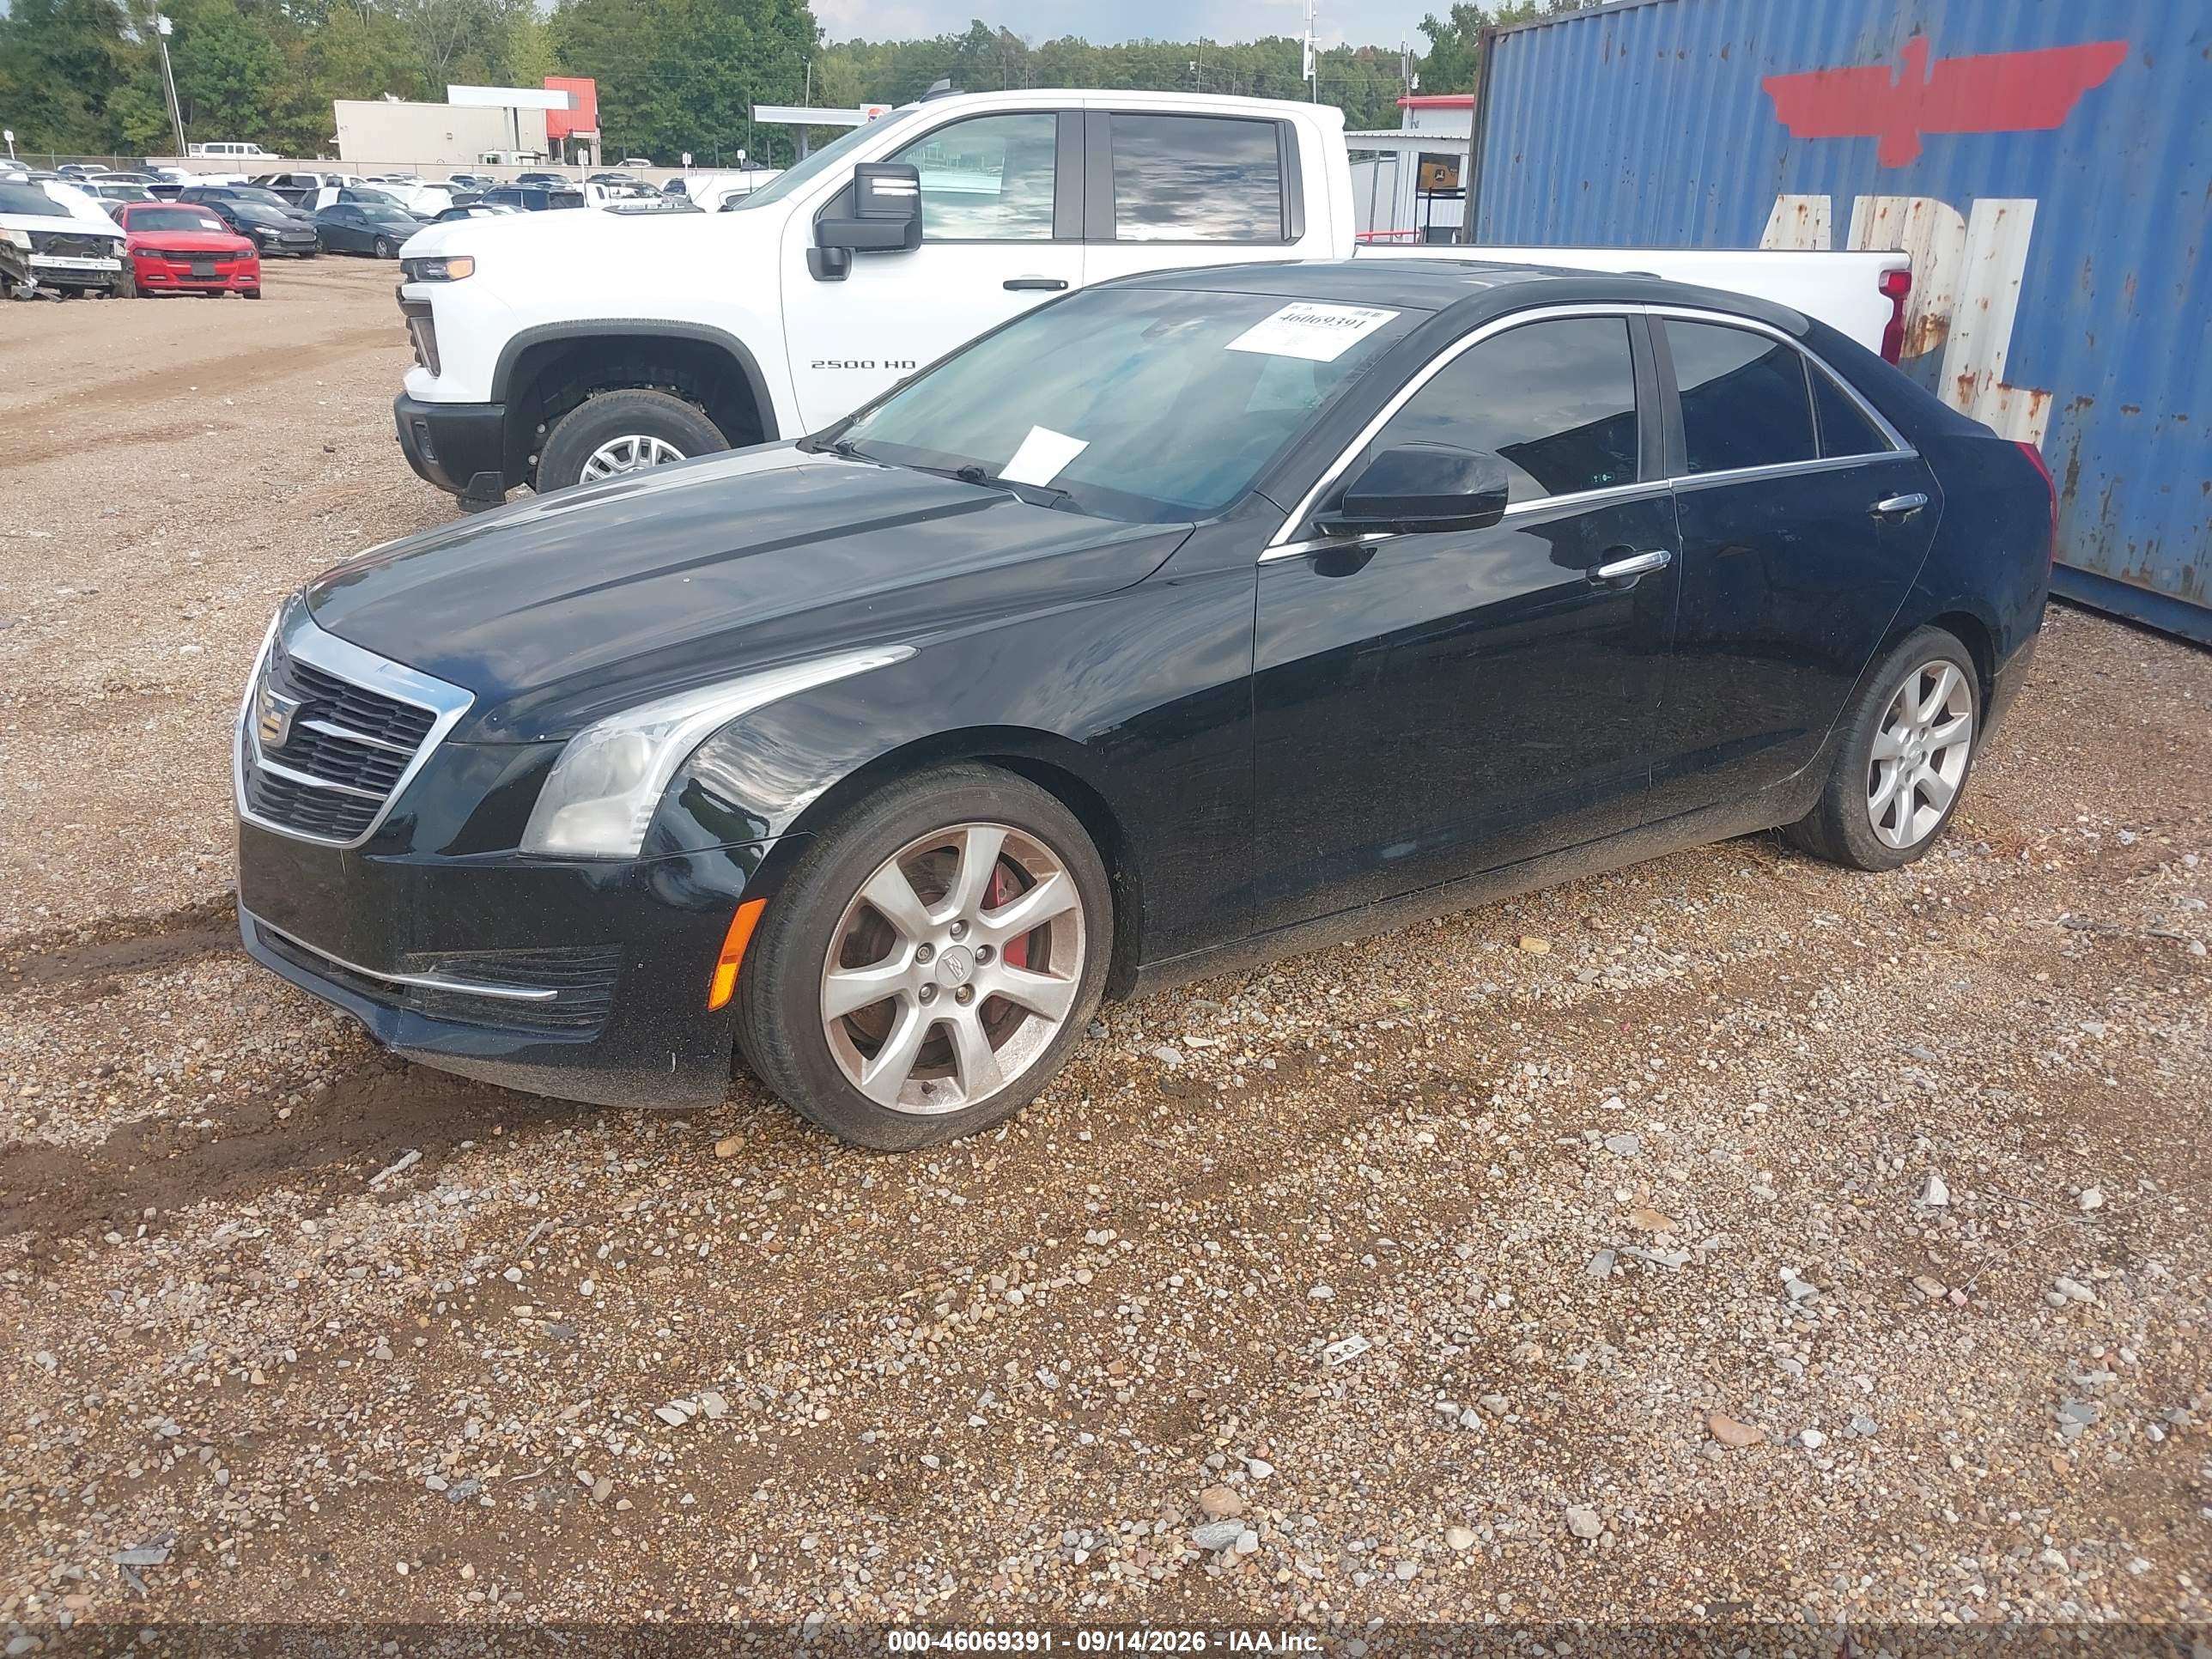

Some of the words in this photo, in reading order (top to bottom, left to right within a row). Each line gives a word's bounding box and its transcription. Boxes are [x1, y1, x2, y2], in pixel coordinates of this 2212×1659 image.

[1279, 313, 1367, 329] 46069391
[1759, 194, 2053, 453] PL
[811, 360, 875, 369] 2500
[884, 360, 916, 369] HD
